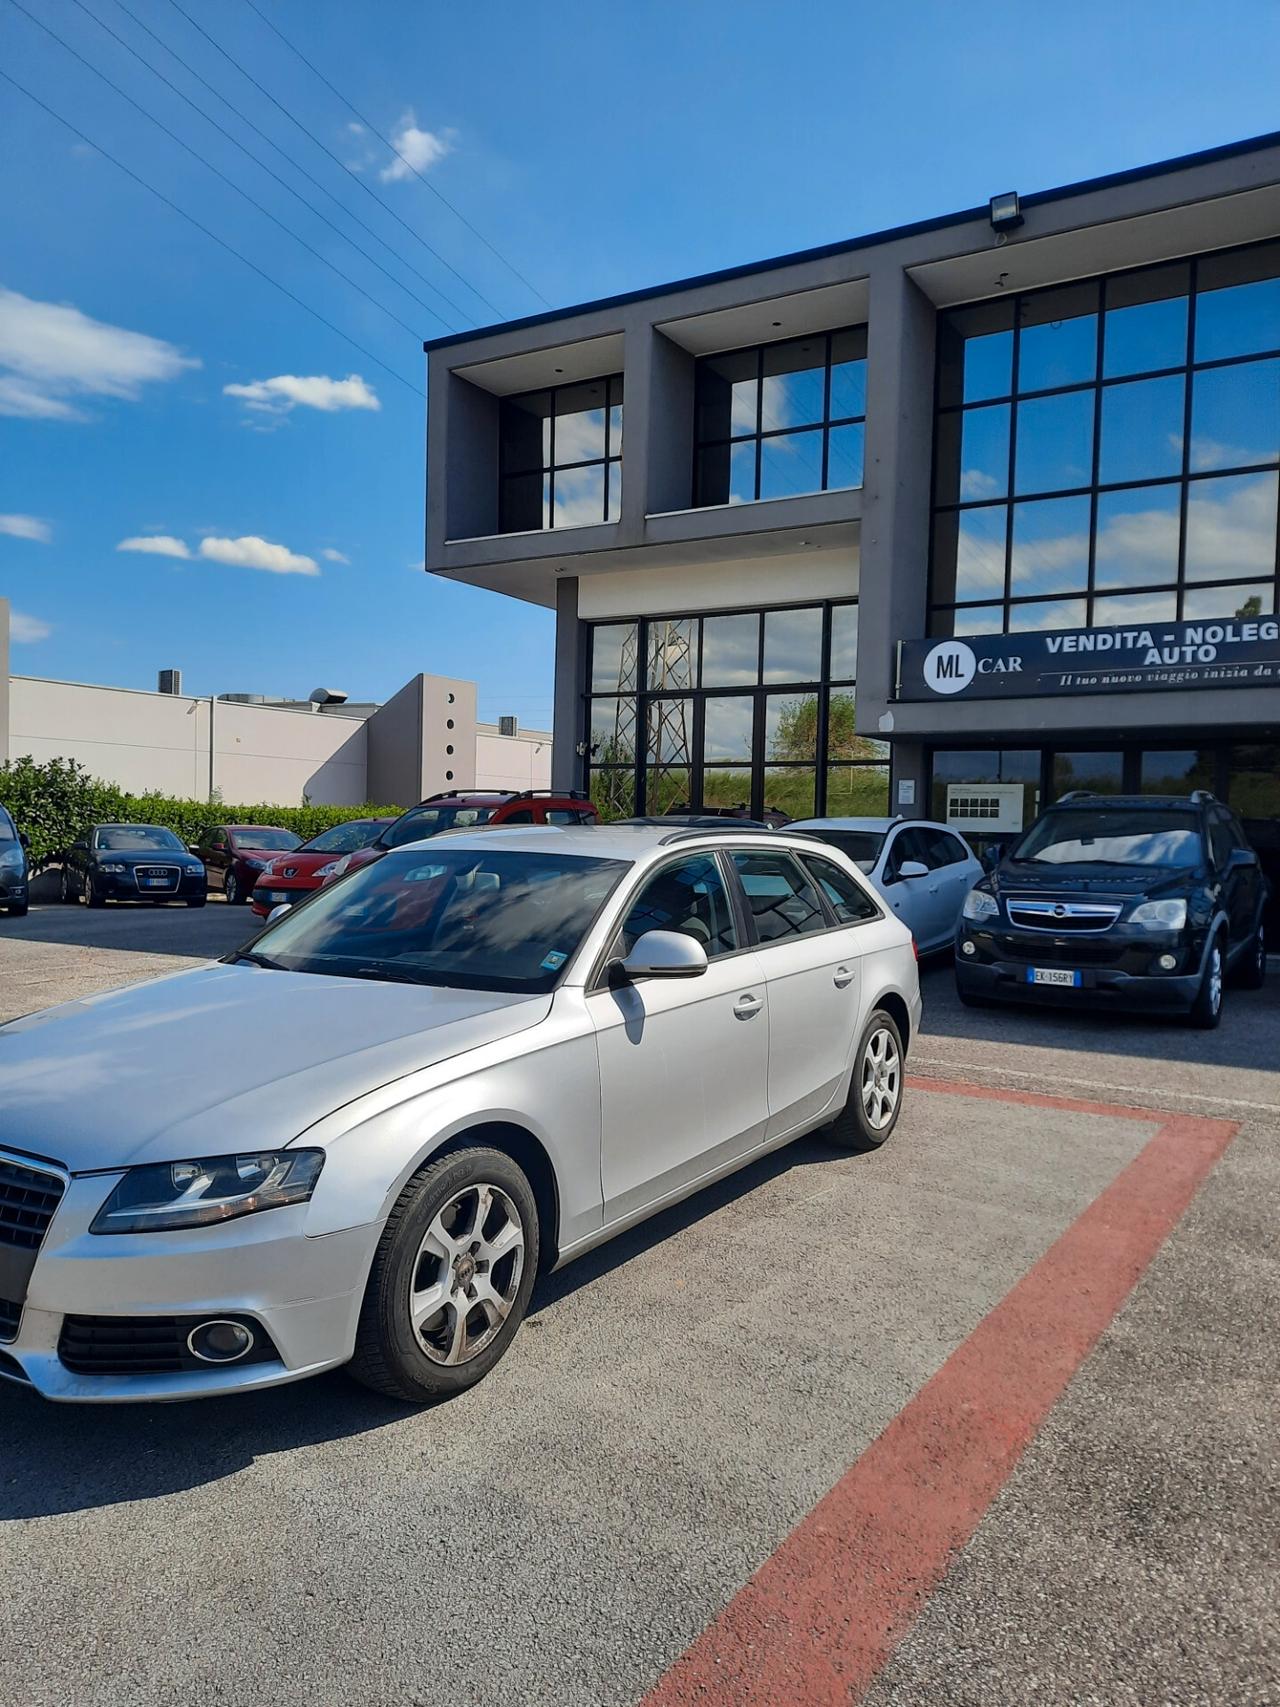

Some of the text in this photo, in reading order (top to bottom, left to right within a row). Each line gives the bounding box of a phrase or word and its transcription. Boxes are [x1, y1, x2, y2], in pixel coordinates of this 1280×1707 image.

[1045, 630, 1155, 654] VENDITA
[1185, 621, 1279, 645] NOLEG
[977, 656, 1023, 674] CAR
[1143, 644, 1218, 666] AUTO
[936, 654, 965, 679] ML
[1060, 674, 1073, 686] Il
[1076, 676, 1098, 686] tuo
[1101, 674, 1143, 685] nuovo
[1147, 668, 1199, 684] viaggio
[1203, 666, 1249, 679] inizia
[1253, 664, 1273, 677] da
